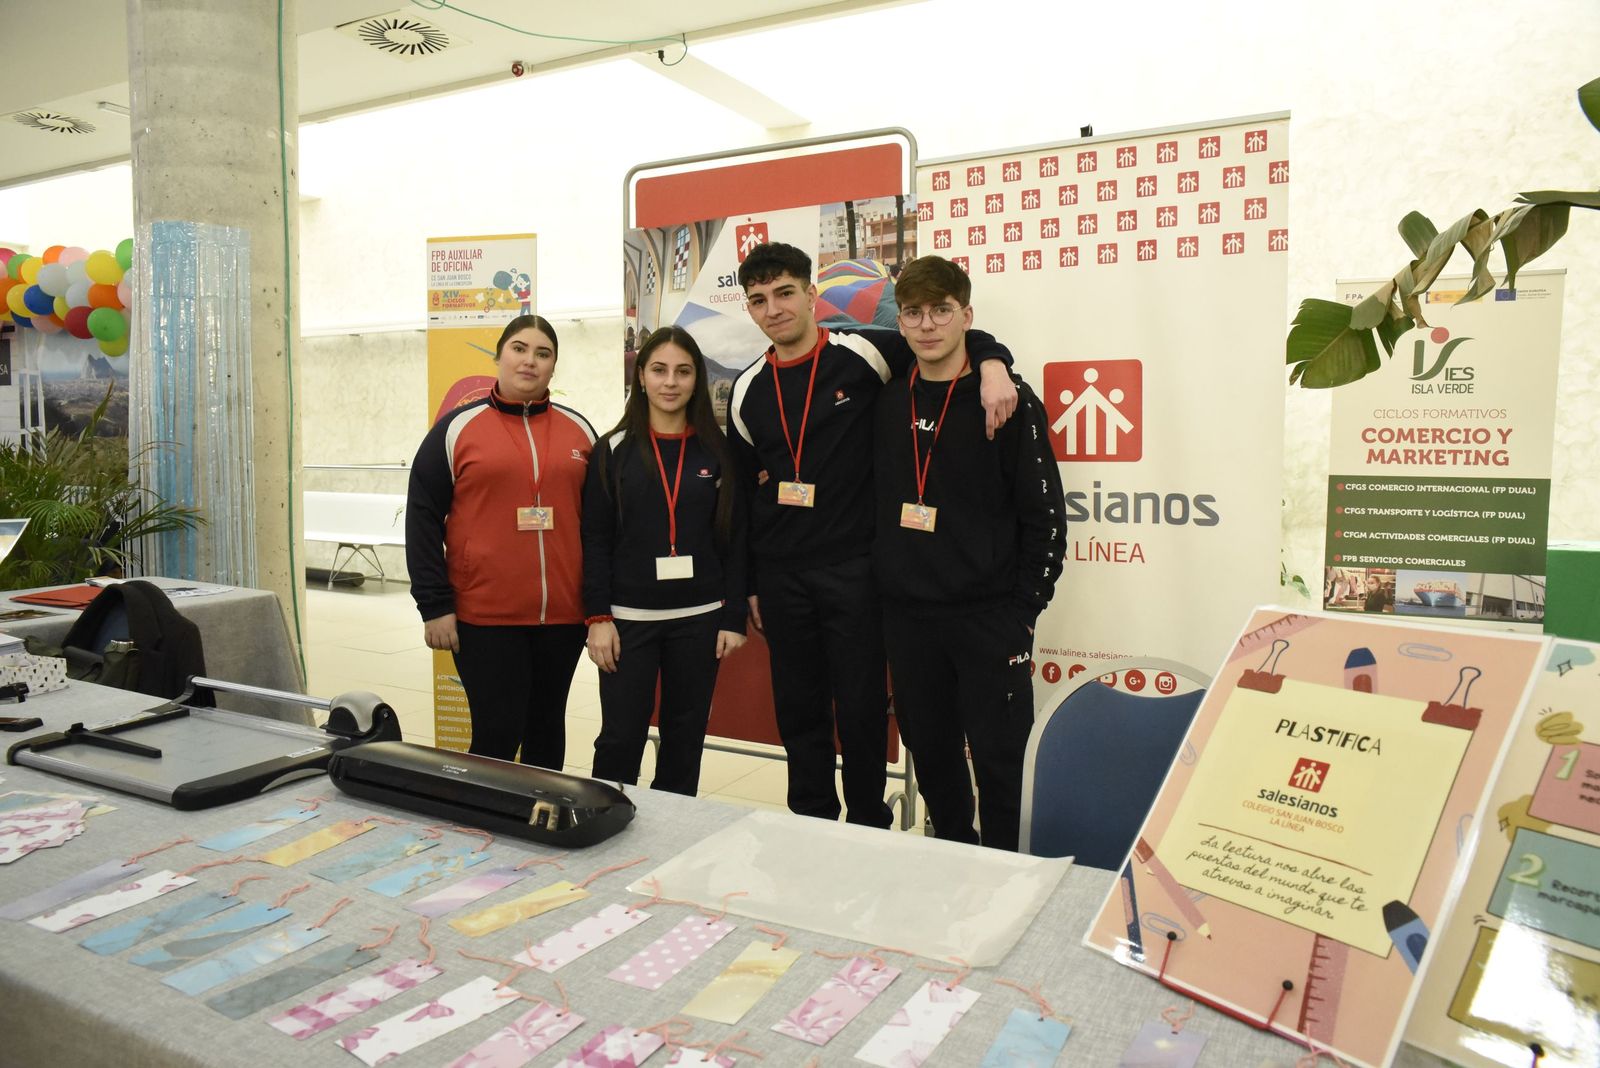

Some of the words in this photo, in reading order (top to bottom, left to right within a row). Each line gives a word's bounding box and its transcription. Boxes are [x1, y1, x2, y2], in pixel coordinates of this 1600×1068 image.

[431, 250, 446, 261] FPB
[448, 249, 483, 260] AUXILIAR
[431, 261, 441, 272] DE
[443, 260, 473, 272] OFICINA
[709, 292, 740, 303] COLEGIO
[1444, 366, 1475, 381] IES
[1411, 383, 1434, 394] ISLA
[1437, 383, 1474, 394] VERDE
[1373, 408, 1419, 419] CICLOS
[1423, 408, 1507, 419] FORMATIVOS
[1361, 427, 1491, 445] COMERCIO
[1496, 428, 1513, 444] Y
[1366, 448, 1510, 466] MARKETING
[1345, 482, 1367, 491] CFGS
[1368, 483, 1415, 492] COMERCIO
[1416, 484, 1490, 493] INTERNACIONAL
[1492, 486, 1507, 494] (FP
[1508, 487, 1536, 495] DUAL)
[1065, 480, 1220, 527] sianos
[1344, 507, 1366, 515] CFGS
[1367, 507, 1423, 517] TRANSPORTE
[1424, 509, 1431, 517] Y
[1432, 508, 1480, 518] LOGÍSTICA
[1482, 511, 1496, 519] (FP
[1498, 511, 1526, 520] DUAL)
[1343, 531, 1367, 539] CFGM
[1369, 532, 1426, 541] ACTIVIDADES
[1427, 533, 1489, 543] COMERCIALES
[1491, 536, 1506, 544] (FP
[1507, 536, 1536, 545] DUAL)
[1075, 536, 1145, 564] LÍNEA
[1342, 554, 1358, 562] FPB
[1359, 555, 1403, 564] SERVICIOS
[1404, 556, 1466, 567] COMERCIALES
[1008, 651, 1030, 666] FILA
[1275, 718, 1382, 756] PLASTIFICA
[1554, 748, 1581, 781] 1
[1257, 787, 1339, 818] salesianos
[1242, 799, 1276, 816] COLEGIO
[1276, 807, 1293, 820] SAN
[1294, 813, 1315, 826] JUAN
[1315, 818, 1344, 834] BOSCO
[1269, 816, 1280, 827] LA
[1200, 835, 1219, 849] La
[1222, 840, 1272, 866] lectura
[1275, 860, 1300, 873] nos
[1302, 864, 1337, 885] abre
[1339, 876, 1367, 895] las
[1506, 853, 1545, 889] 2
[1185, 849, 1241, 871] puertas
[1243, 863, 1268, 880] del
[1269, 873, 1316, 896] mundo
[1318, 890, 1349, 905] que
[1350, 896, 1369, 912] te
[1202, 866, 1253, 891] atrevas
[1255, 886, 1263, 896] a
[1266, 888, 1335, 920] imaginar.
